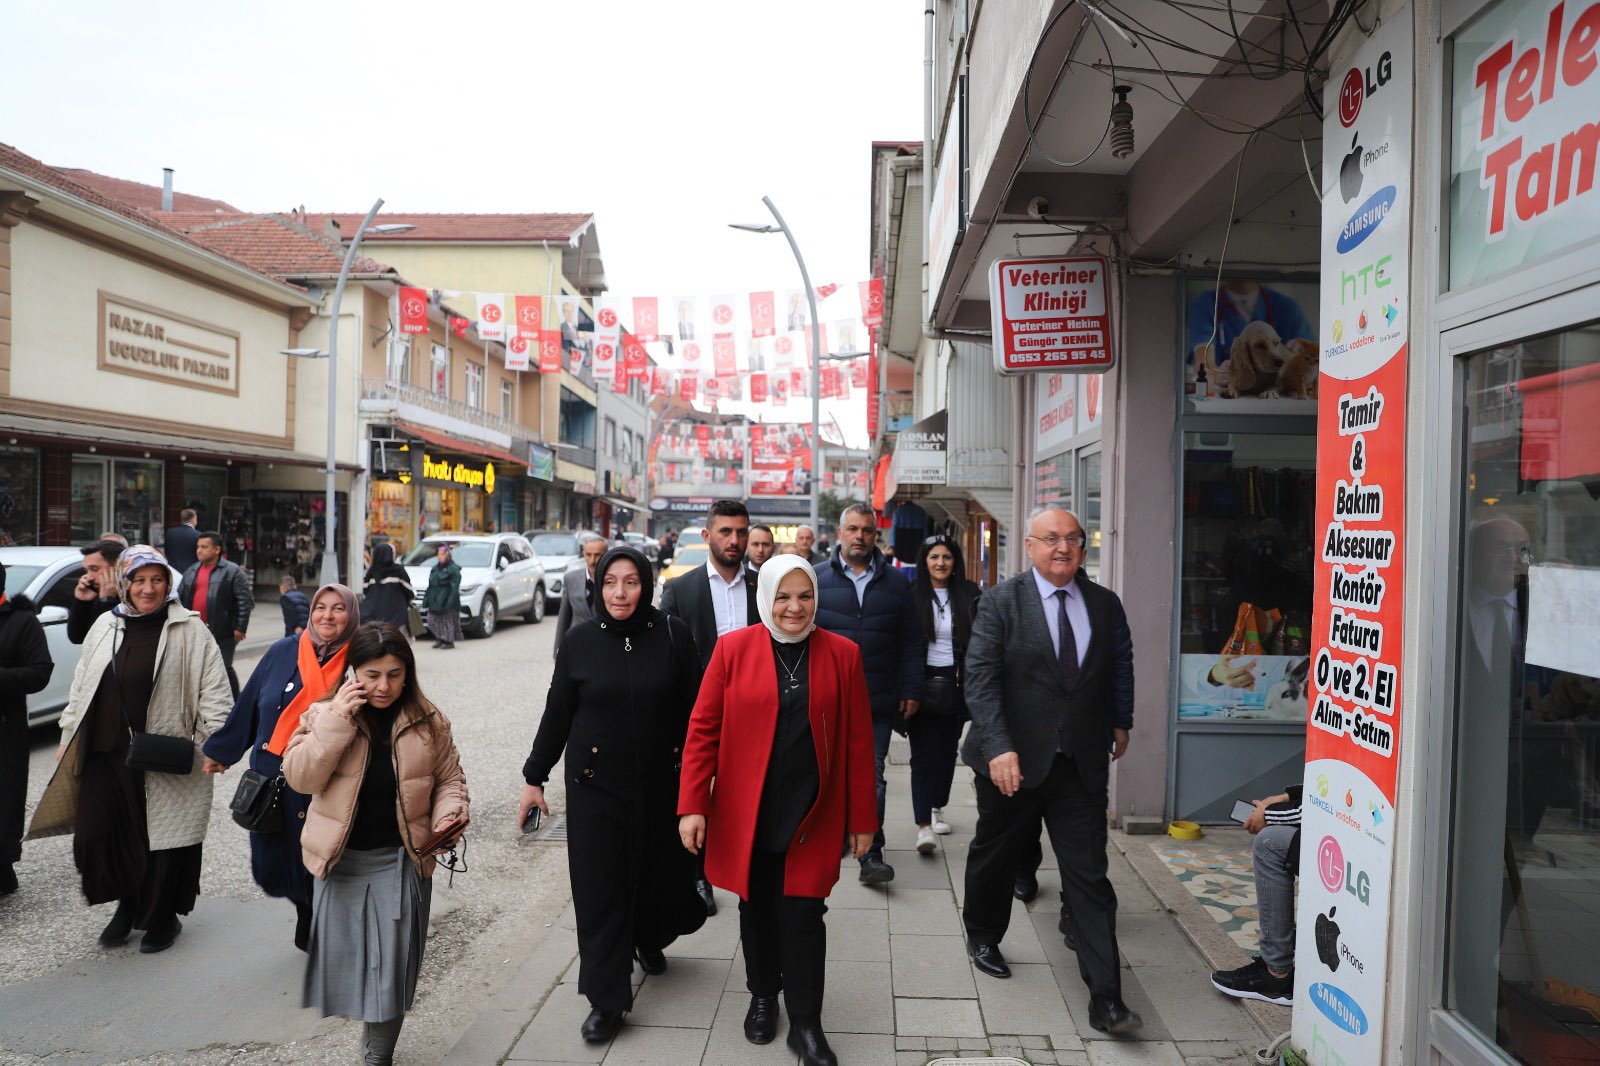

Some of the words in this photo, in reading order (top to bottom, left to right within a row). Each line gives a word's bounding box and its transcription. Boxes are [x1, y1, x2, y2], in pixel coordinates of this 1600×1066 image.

[1366, 51, 1392, 98] LG
[1363, 141, 1389, 168] iPhone
[1343, 201, 1389, 240] SAMSUNG
[1009, 266, 1097, 286] Veteriner
[1024, 290, 1087, 314] Kliniği
[109, 312, 166, 342] NAZAR
[521, 331, 539, 339] MHP
[1011, 321, 1063, 332] Veteriner
[1067, 320, 1100, 330] Hekim
[1019, 337, 1058, 348] Güngör
[1062, 333, 1098, 345] DEMİR
[109, 340, 180, 370] UCUZLUK
[183, 357, 230, 381] PAZARI
[1010, 353, 1041, 363] 0553
[1044, 352, 1067, 361] 265
[1071, 351, 1087, 360] 95
[1090, 350, 1106, 359] 45
[1325, 345, 1348, 359] TURKCELL
[1349, 335, 1375, 351] vodafone
[1340, 393, 1381, 430] Tamir
[1352, 440, 1363, 470] &
[1337, 486, 1380, 516] Bakım
[1326, 528, 1392, 561] Aksesuar
[1333, 572, 1382, 605] Kontör
[1331, 614, 1380, 651] Fatura
[1333, 668, 1351, 695] ve
[1355, 665, 1370, 701] 2.
[1375, 669, 1393, 708] El
[1315, 700, 1342, 730] Alım
[1353, 714, 1391, 749] Satım
[1309, 794, 1333, 815] TURKCELL
[1336, 811, 1361, 831] vodafone
[1346, 862, 1370, 906] LG
[1339, 943, 1364, 975] iPhone
[1317, 983, 1361, 1035] SAMSUNG
